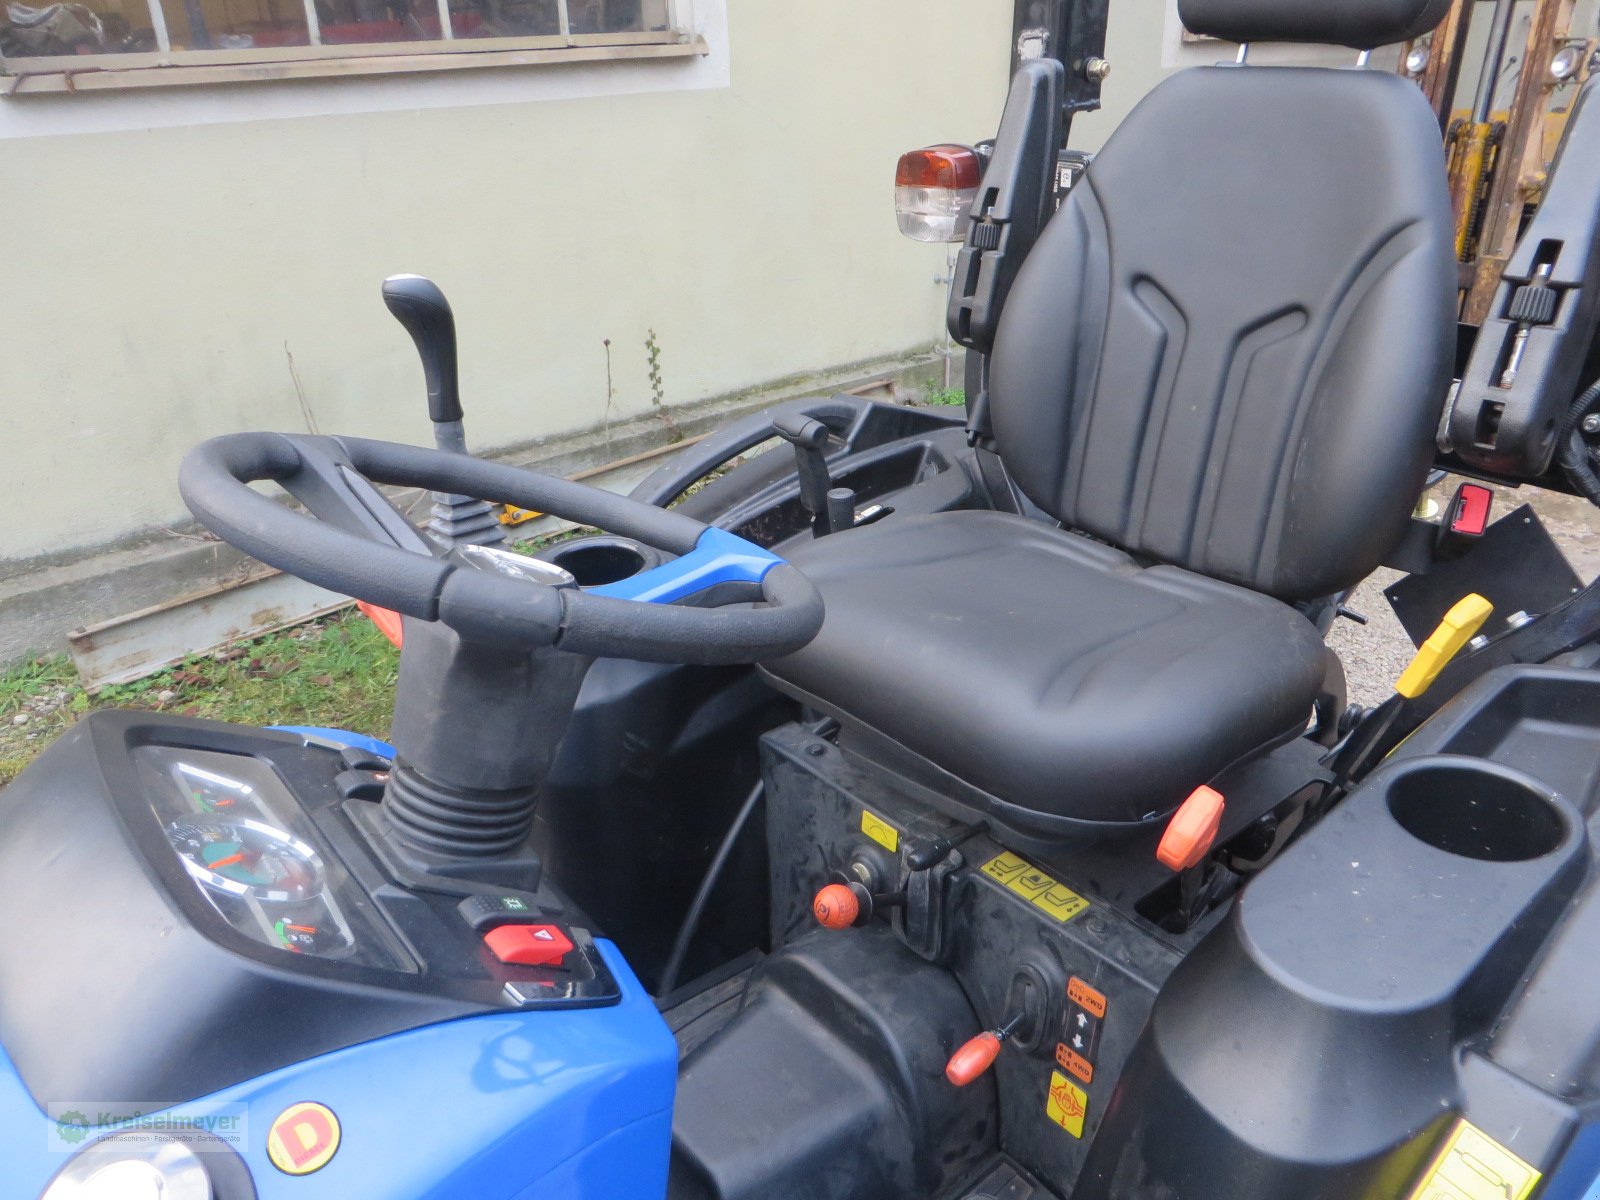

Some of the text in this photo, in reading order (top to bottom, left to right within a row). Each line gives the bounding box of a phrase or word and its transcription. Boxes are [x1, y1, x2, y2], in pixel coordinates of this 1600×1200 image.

[1085, 995, 1103, 1010] 2WD
[1073, 1062, 1090, 1076] 4WD
[275, 1108, 333, 1169] D
[294, 1142, 325, 1165] DIESEL
